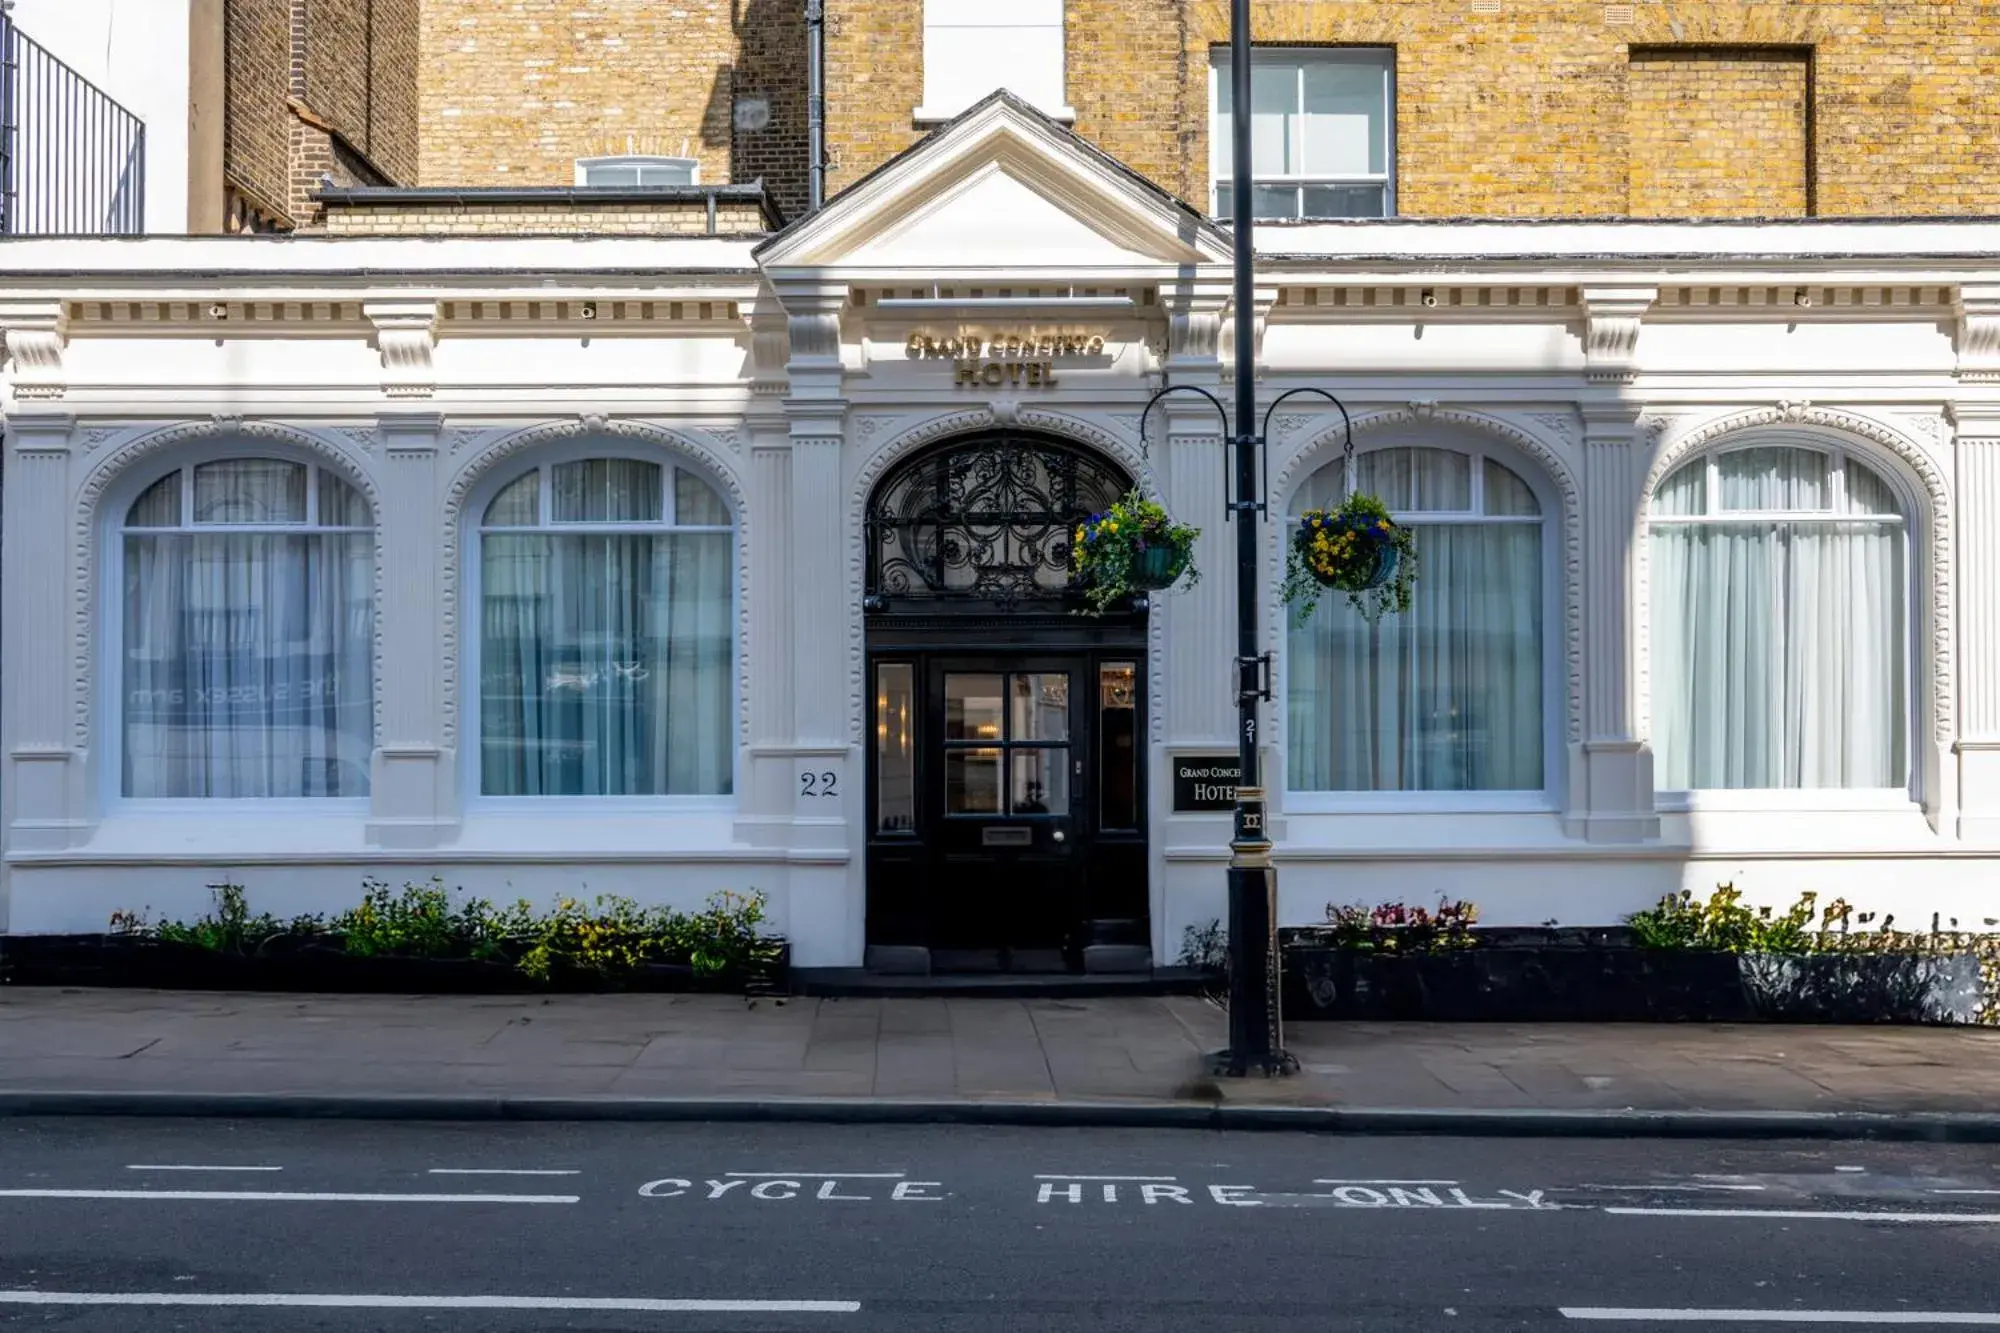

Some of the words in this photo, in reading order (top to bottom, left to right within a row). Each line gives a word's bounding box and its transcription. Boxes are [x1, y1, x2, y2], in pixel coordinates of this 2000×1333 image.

[954, 359, 1058, 386] HOTEL
[800, 772, 839, 796] 22
[1180, 767, 1209, 778] GRAND
[637, 1178, 943, 1200] CYCLE
[1036, 1183, 1263, 1205] HIRE
[1331, 1185, 1545, 1208] ONLY
